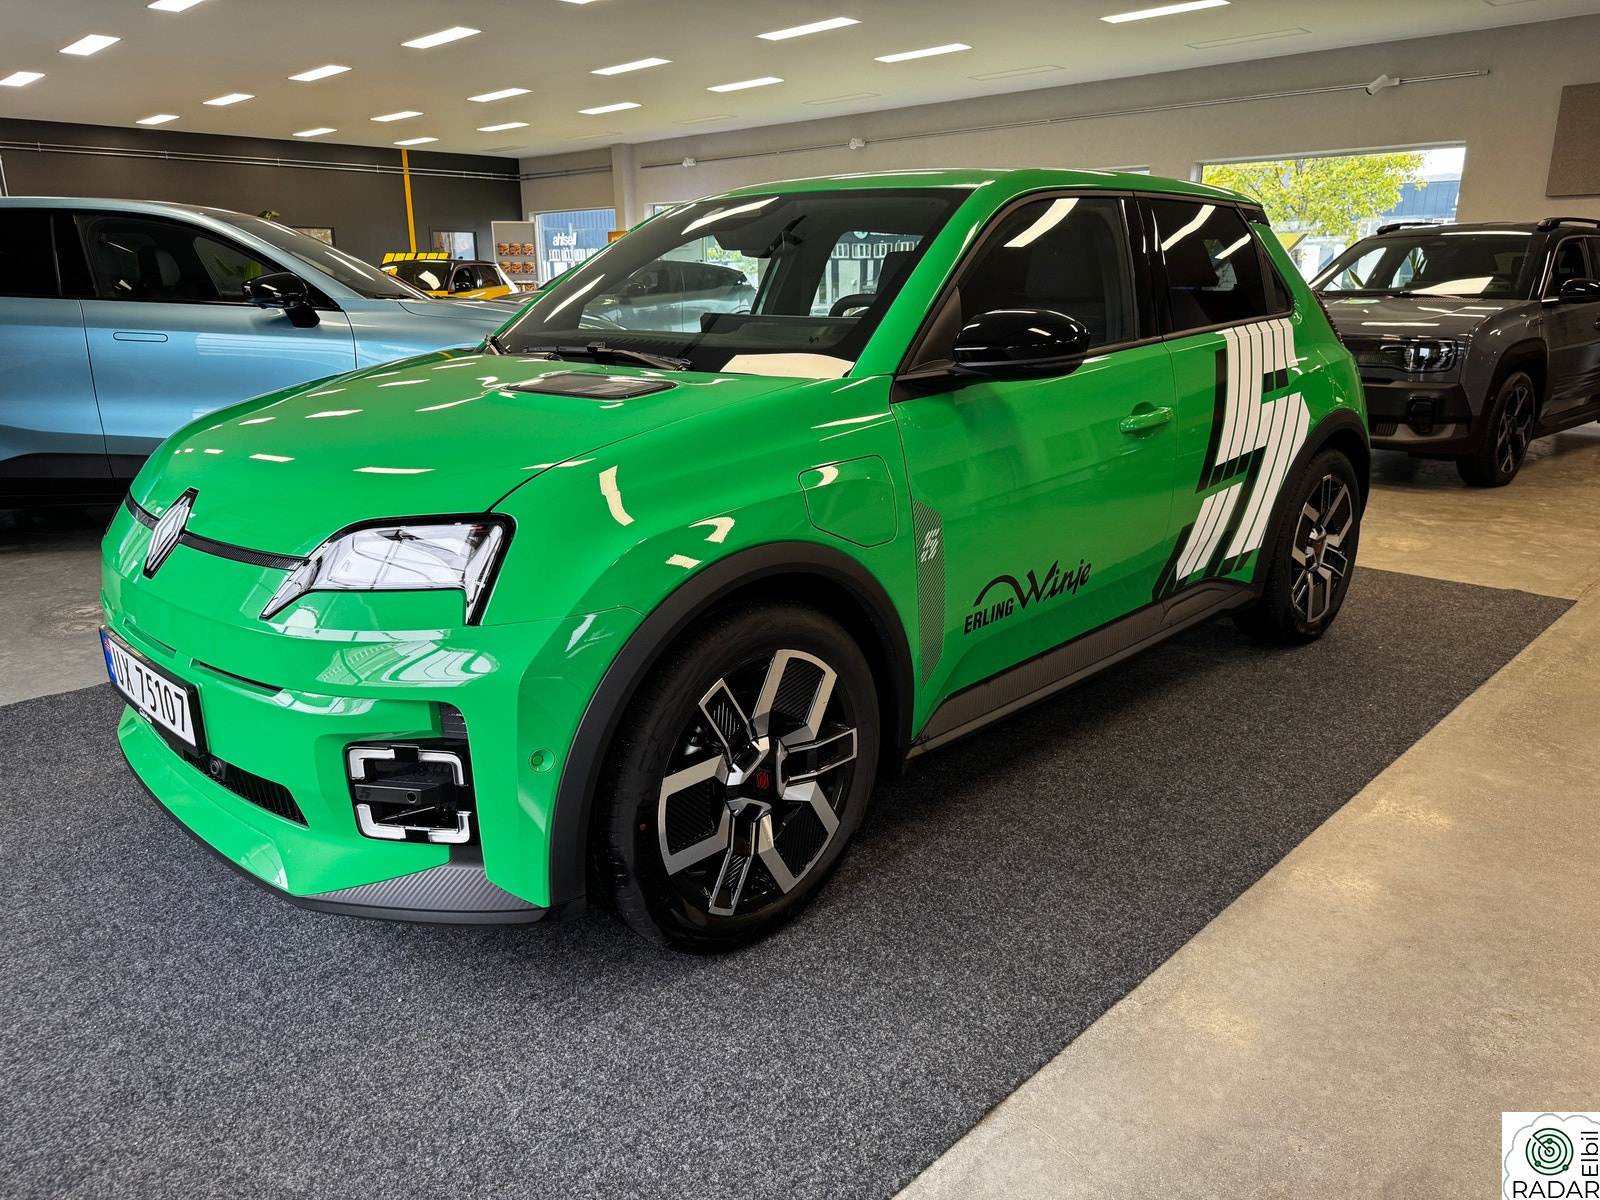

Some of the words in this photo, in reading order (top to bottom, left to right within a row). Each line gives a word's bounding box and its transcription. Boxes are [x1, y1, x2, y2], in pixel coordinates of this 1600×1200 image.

[552, 232, 577, 247] ahlsell
[972, 558, 1092, 610] Winje
[964, 597, 1014, 635] ERLING
[112, 646, 134, 695] UX
[135, 665, 185, 732] 75107
